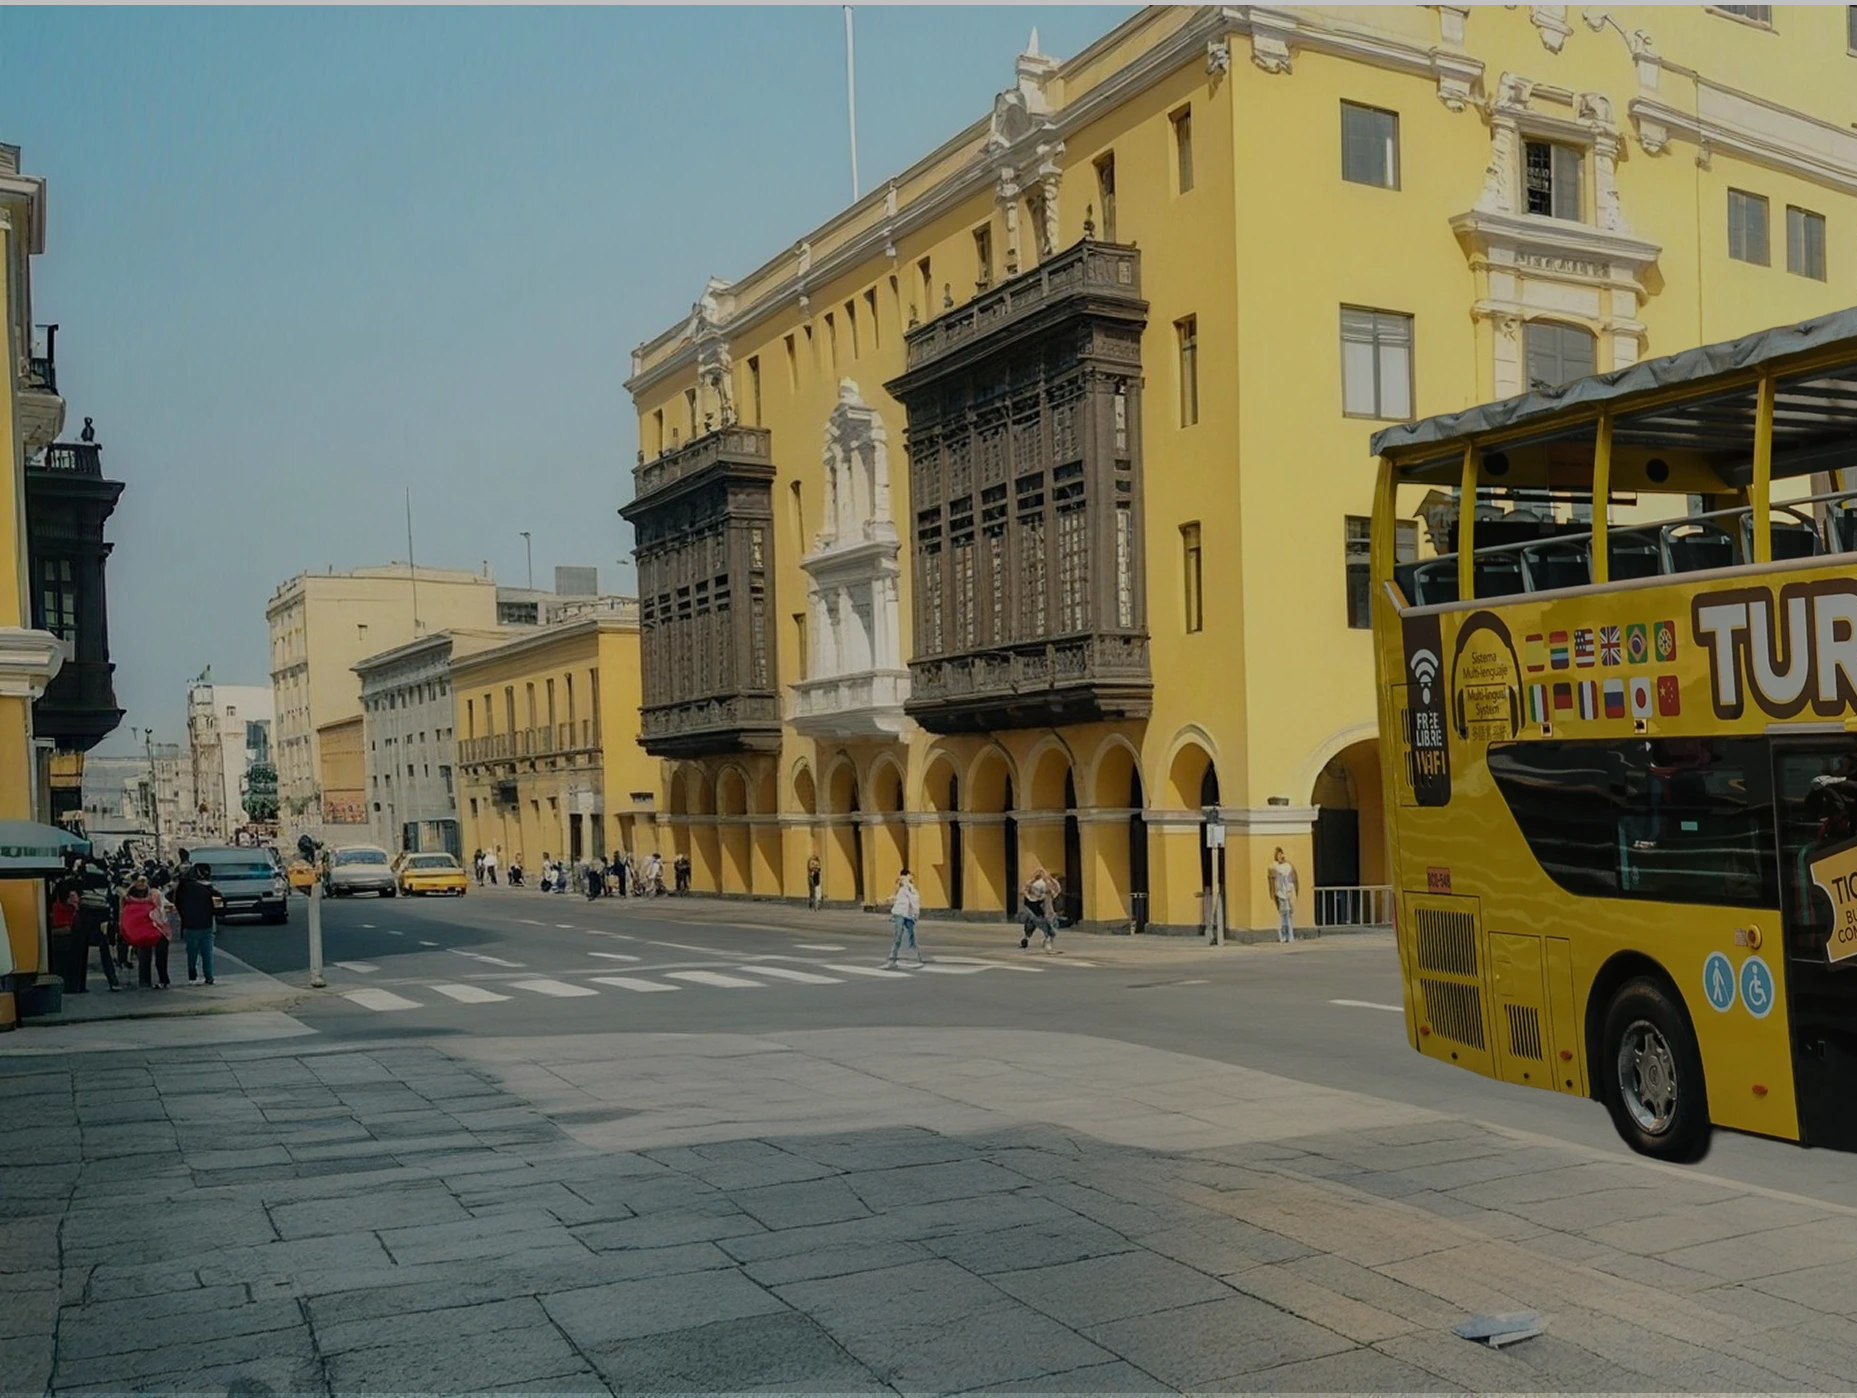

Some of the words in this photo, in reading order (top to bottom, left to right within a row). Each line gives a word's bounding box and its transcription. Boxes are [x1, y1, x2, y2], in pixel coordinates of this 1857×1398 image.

[1471, 652, 1497, 663] Sistema
[1463, 662, 1508, 681] Multi-lenguaje
[1467, 688, 1507, 704] Multi-lingual
[1476, 702, 1499, 716] System
[1416, 712, 1439, 730] FREE
[1416, 729, 1442, 747] LIBRE
